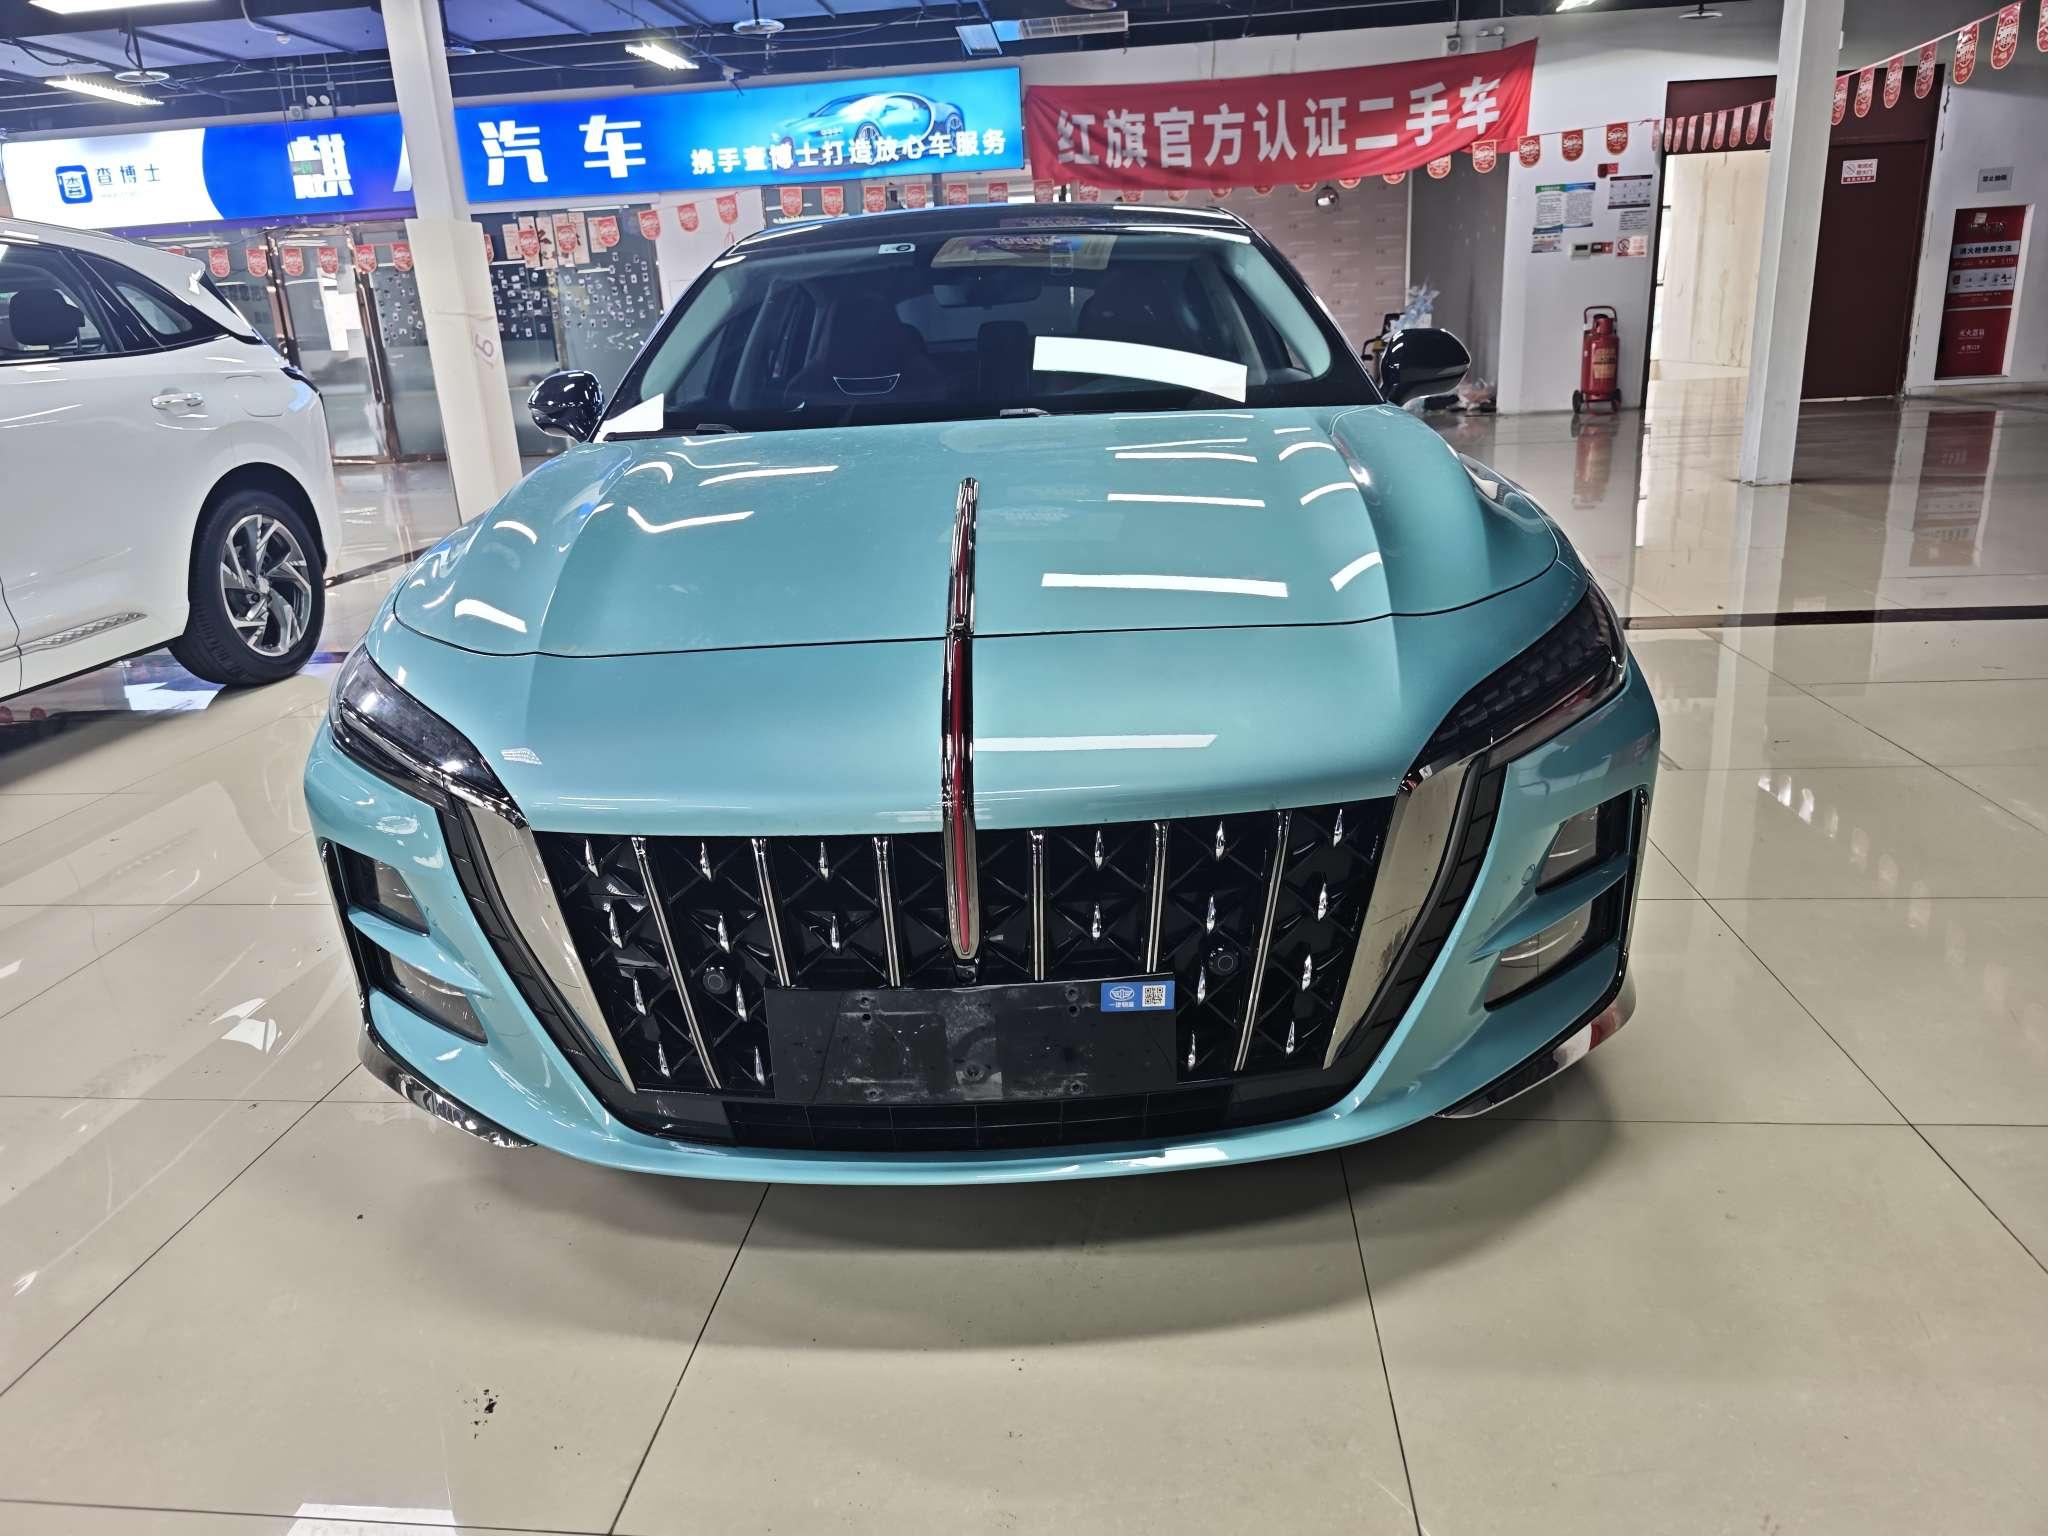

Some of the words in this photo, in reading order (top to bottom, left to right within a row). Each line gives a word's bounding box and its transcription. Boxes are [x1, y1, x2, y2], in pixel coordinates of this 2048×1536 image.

[1056, 76, 1501, 169] 红旗官方认证二手车
[97, 163, 160, 185] 查博士
[691, 128, 1006, 174] 携手查博士打造放心车服务
